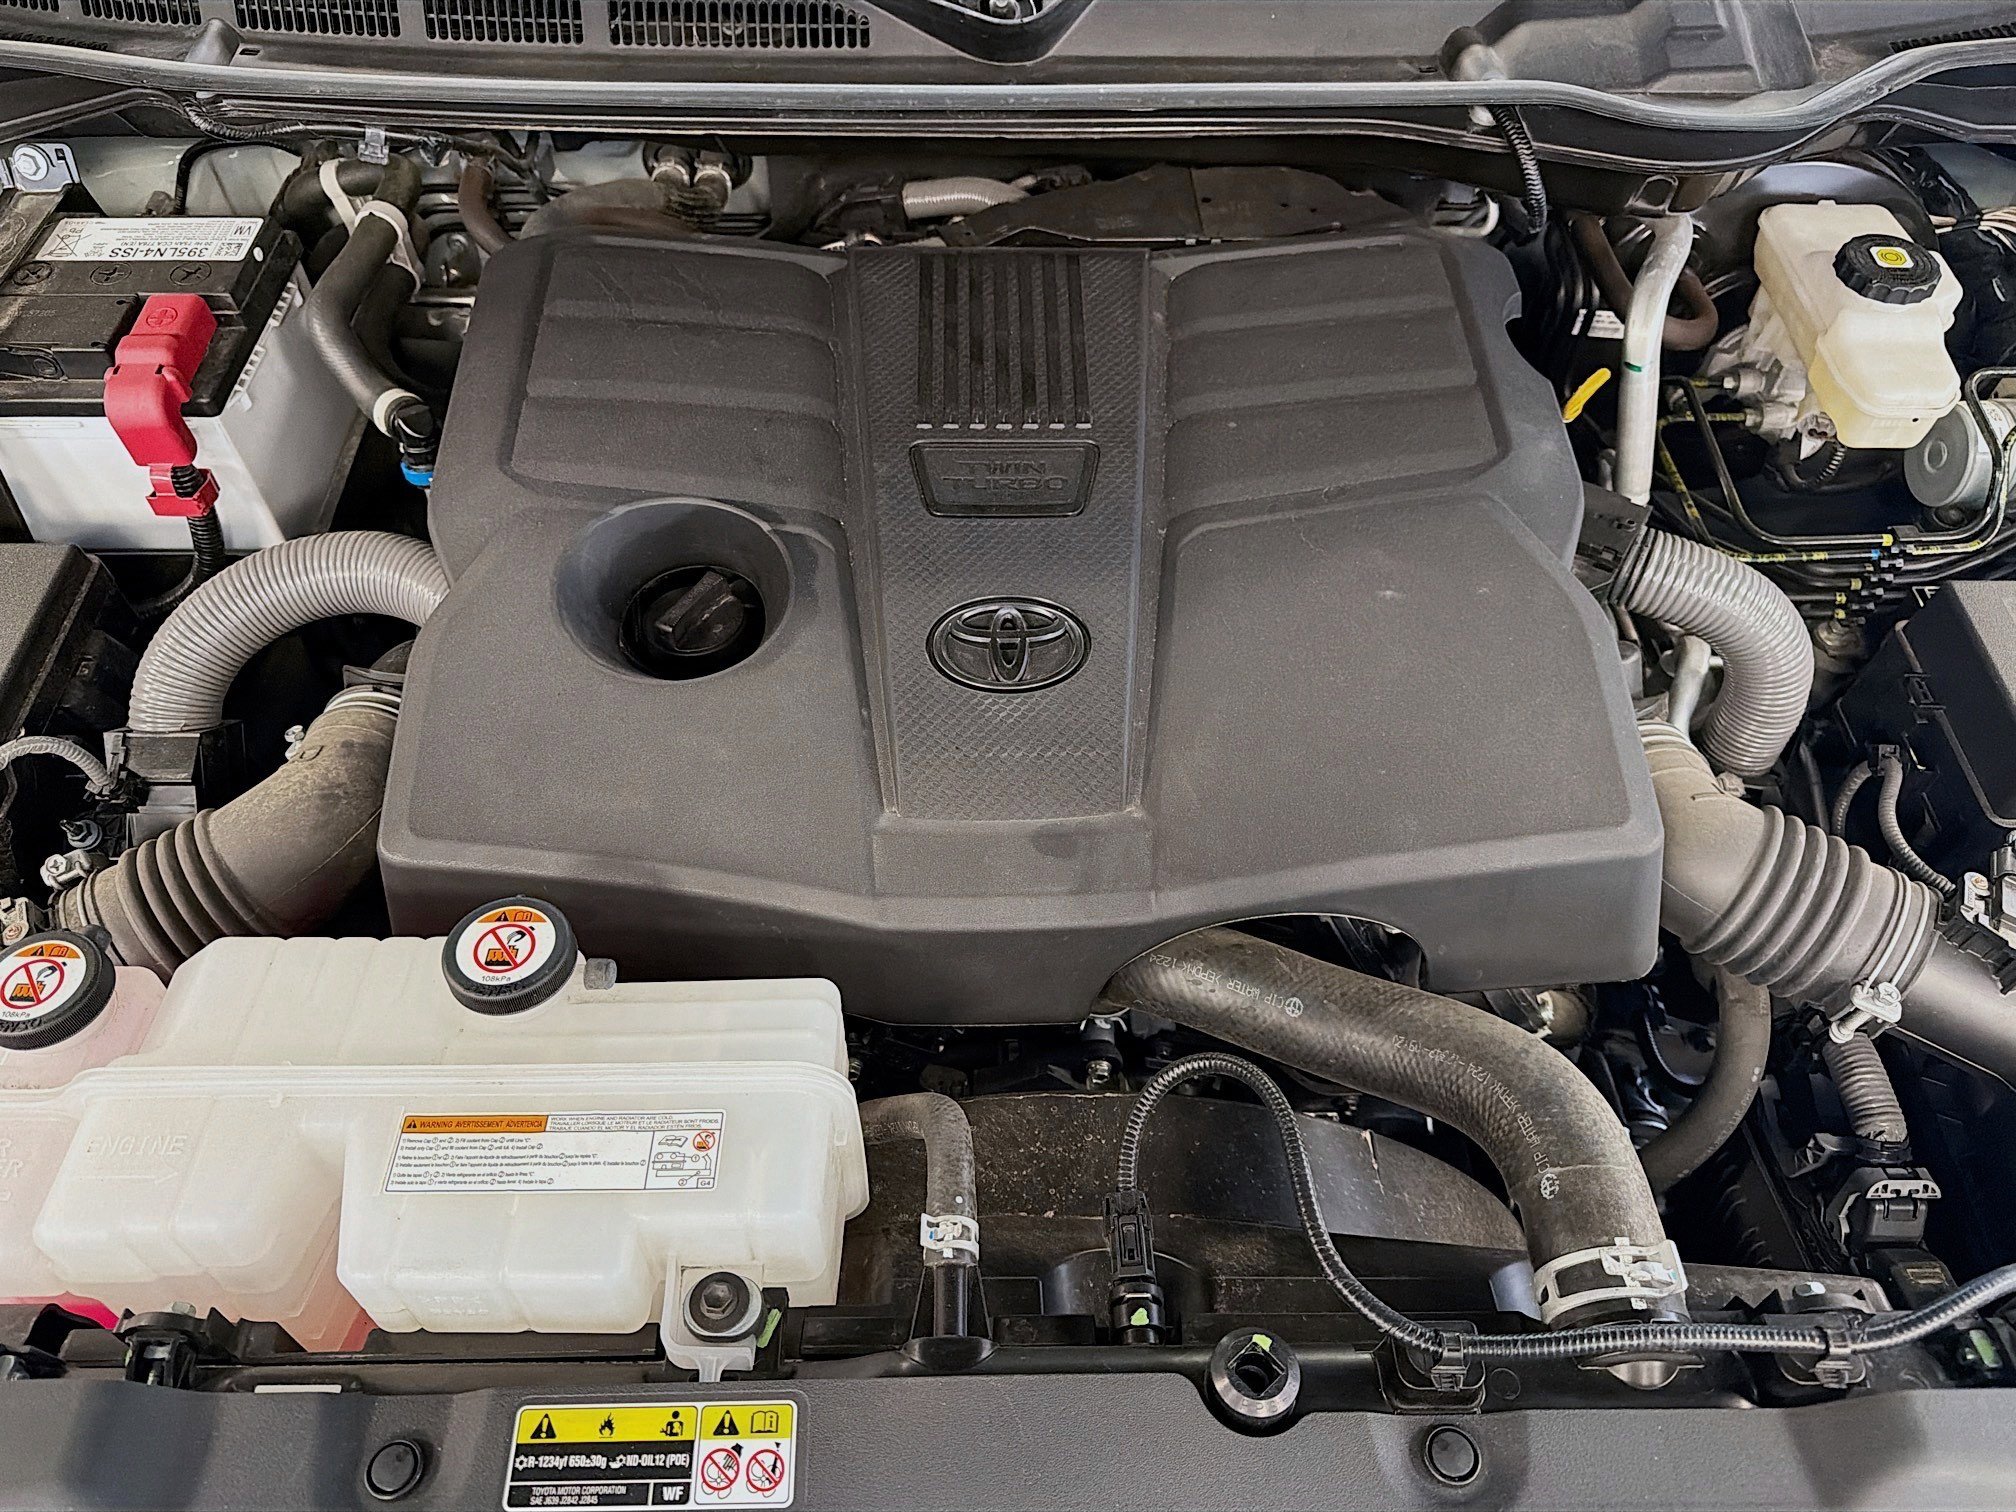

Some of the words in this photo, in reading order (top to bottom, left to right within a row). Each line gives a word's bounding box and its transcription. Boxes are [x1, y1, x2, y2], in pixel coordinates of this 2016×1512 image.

[108, 247, 208, 258] 395LN4-ISS
[954, 459, 1046, 475] TWIN
[940, 475, 1069, 491] TURBO
[1149, 953, 1177, 969] 1224
[1226, 977, 1260, 1000] WATER
[1517, 1112, 1543, 1148] WATER
[86, 1135, 187, 1155] ENGINE
[527, 1455, 568, 1470] R-1234yf
[568, 1454, 608, 1469] 650±30g
[665, 1453, 690, 1468] (POE)
[531, 1486, 556, 1496] TOYOTA
[557, 1486, 581, 1495] MOTOR
[581, 1485, 627, 1495] CORPORATION
[662, 1485, 684, 1501] WF
[529, 1496, 544, 1505] SAE
[543, 1496, 559, 1505] J639
